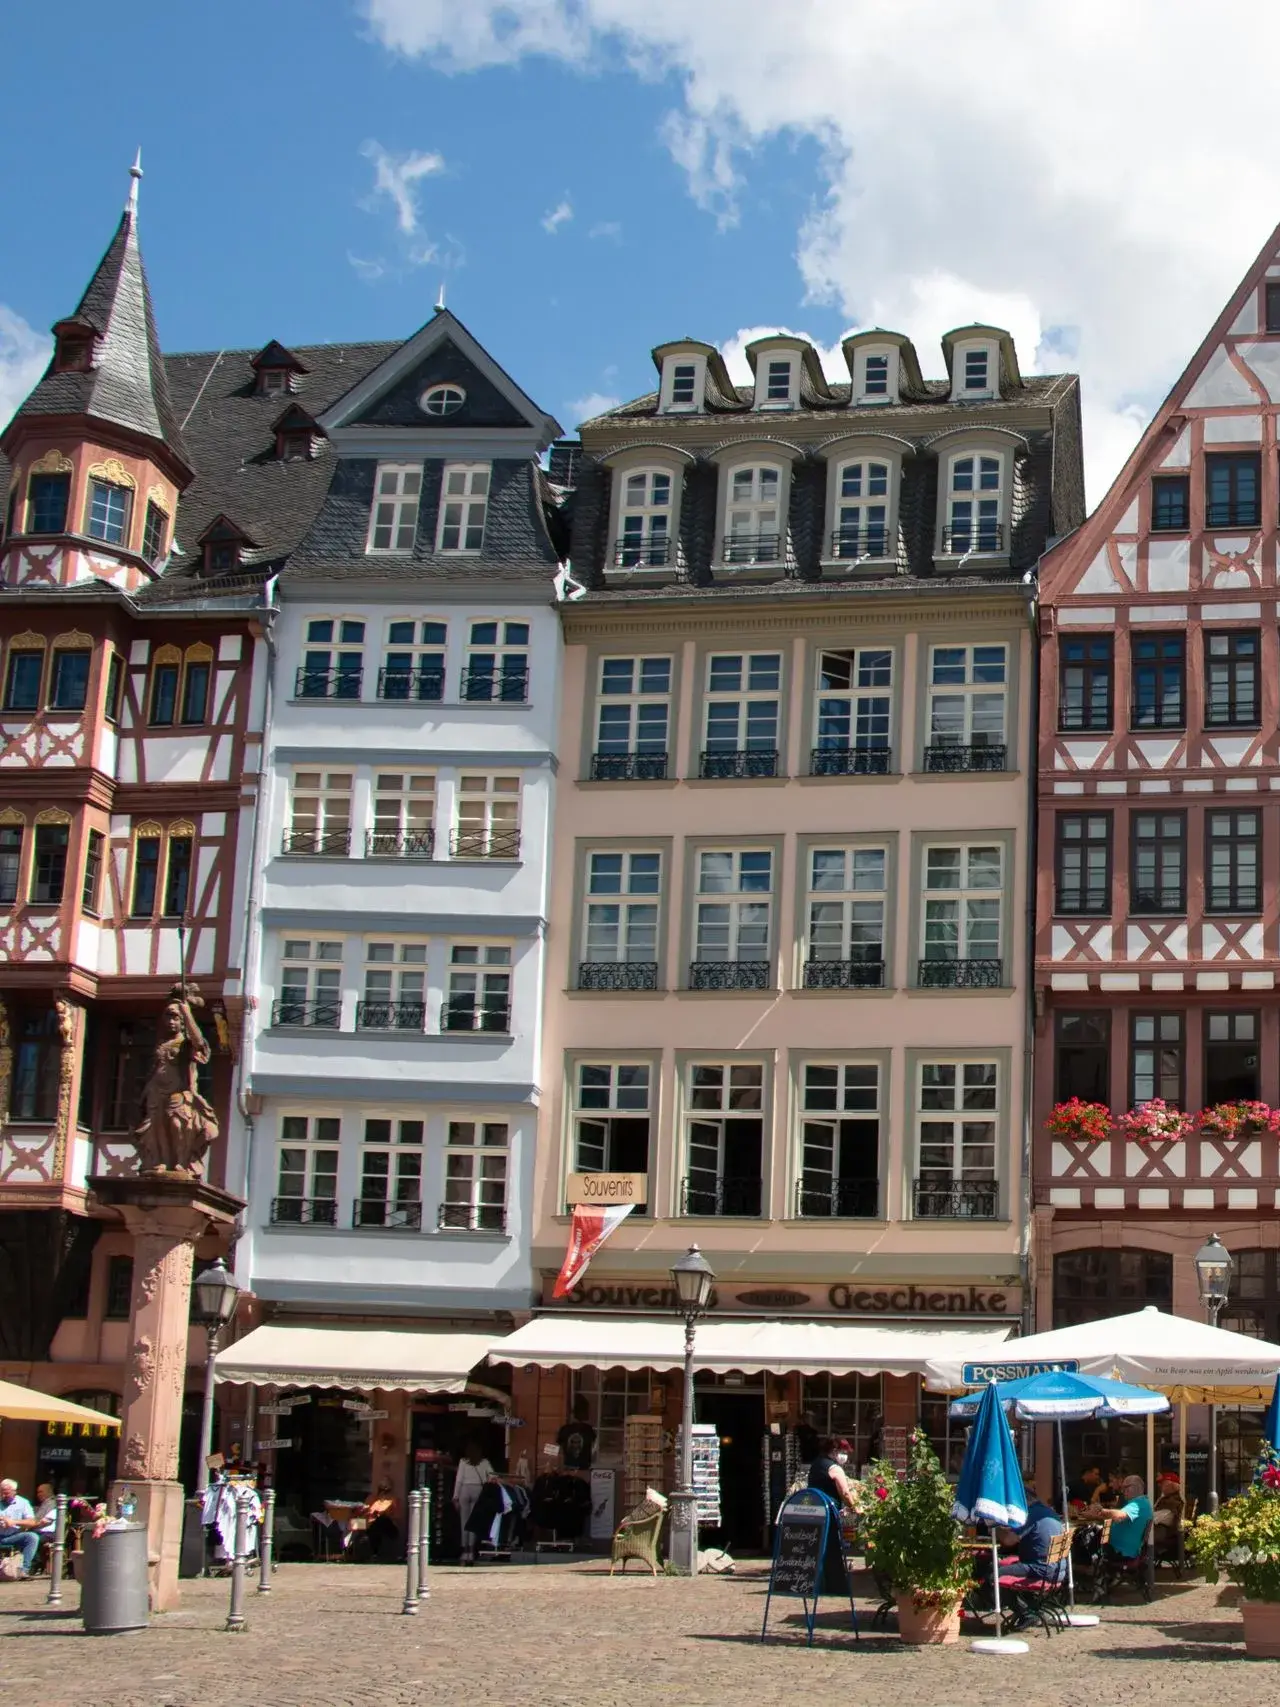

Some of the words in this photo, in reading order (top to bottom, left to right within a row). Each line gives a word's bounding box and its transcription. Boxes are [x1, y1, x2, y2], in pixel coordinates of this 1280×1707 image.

[583, 1176, 633, 1196] Souvenirs
[568, 1281, 718, 1307] Souvens
[828, 1284, 1007, 1312] Geschenke
[1155, 1366, 1169, 1374] Das
[1203, 1367, 1214, 1375] ein
[1215, 1367, 1233, 1377] Apfel
[1234, 1367, 1260, 1376] werden
[51, 1448, 72, 1457] ATM
